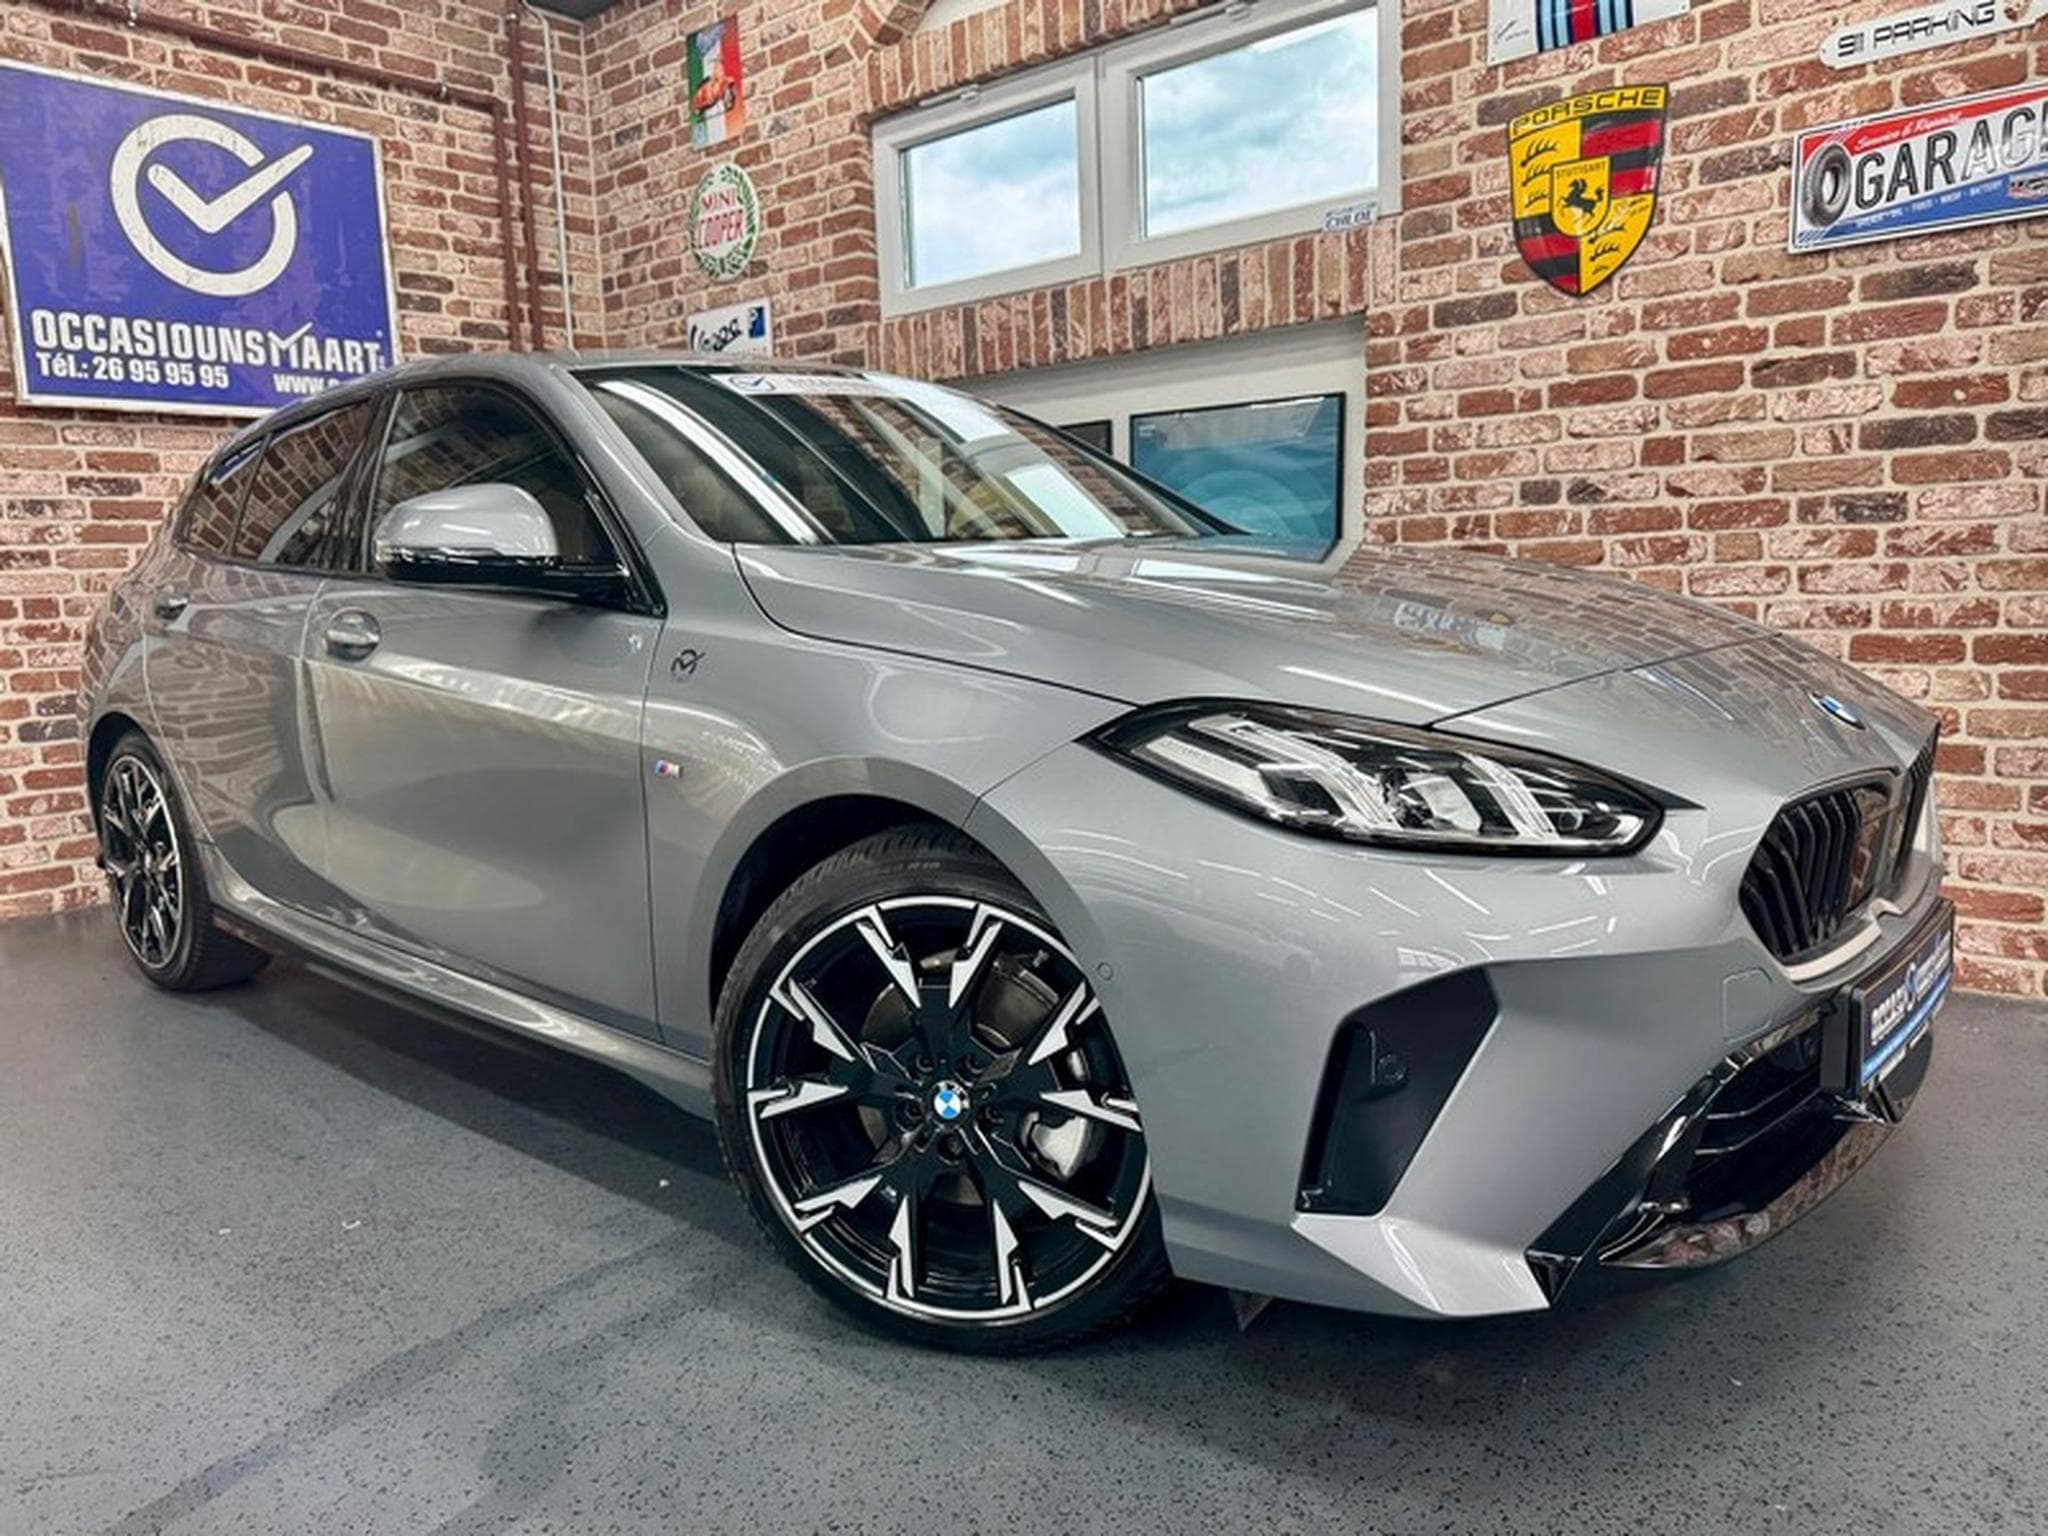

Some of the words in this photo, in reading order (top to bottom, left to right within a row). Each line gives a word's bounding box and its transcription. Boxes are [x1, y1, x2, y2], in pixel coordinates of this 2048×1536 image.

[1874, 1, 1995, 48] PARKING
[1512, 89, 1662, 136] PORSCHE
[1855, 101, 2048, 210] GARAG
[701, 187, 736, 212] MINI
[697, 208, 743, 249] COOPER
[31, 308, 381, 374] OCCASIOUNSMAART
[36, 351, 88, 379] Tél.:
[93, 356, 125, 382] 26
[129, 358, 161, 385] 95
[165, 361, 196, 387] 95
[200, 364, 230, 389] 95
